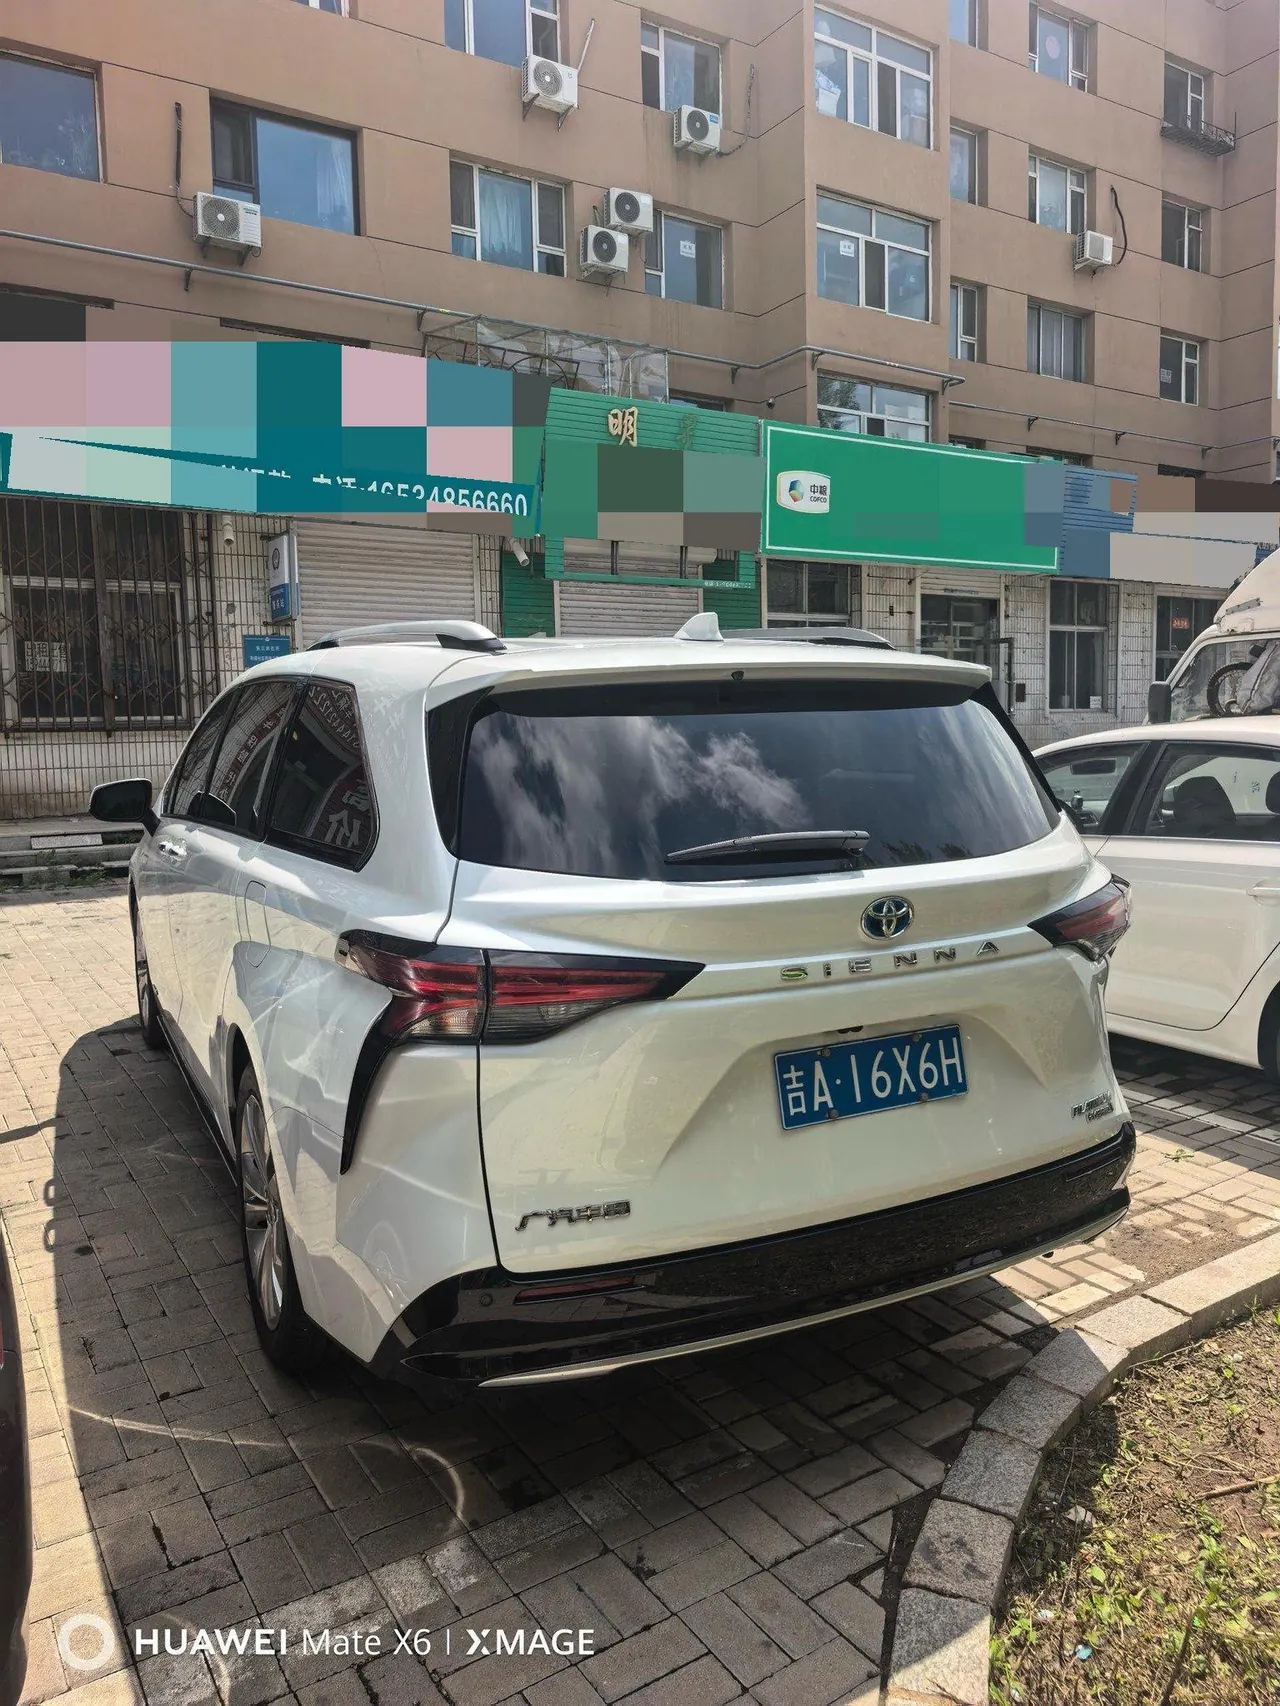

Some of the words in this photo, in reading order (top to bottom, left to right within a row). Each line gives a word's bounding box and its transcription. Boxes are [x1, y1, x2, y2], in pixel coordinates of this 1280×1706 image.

[608, 406, 638, 447] 明
[810, 484, 828, 496] 中粮
[780, 940, 1000, 981] SIENNA
